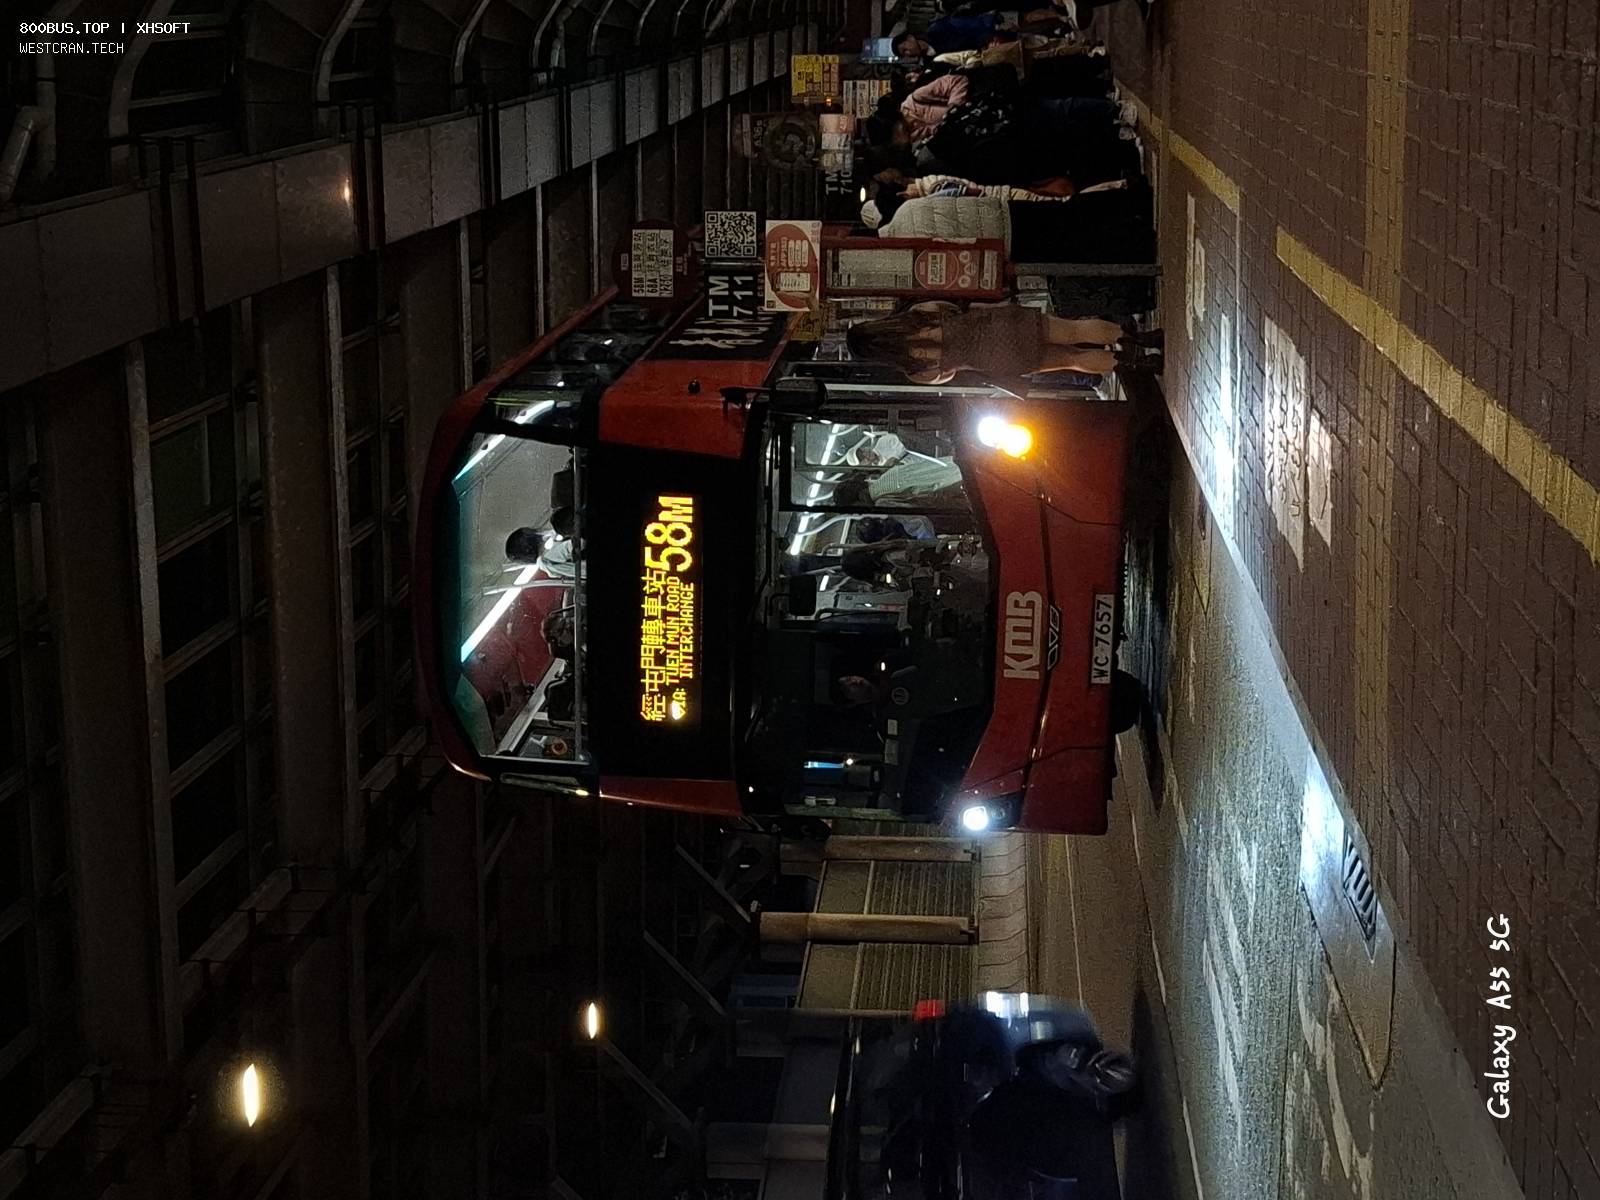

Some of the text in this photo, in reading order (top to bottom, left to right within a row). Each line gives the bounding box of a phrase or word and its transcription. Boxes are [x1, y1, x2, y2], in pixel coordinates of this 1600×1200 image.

[825, 170, 839, 195] TM
[840, 170, 854, 195] 710
[633, 277, 644, 294] 58M
[646, 278, 658, 294] 68A
[708, 275, 730, 317] TM
[733, 275, 754, 318] 711
[644, 495, 694, 572] 58M
[640, 568, 667, 722] 經屯門轉車站
[666, 576, 680, 686] TUEN MUN ROAD
[679, 581, 694, 679] INTERCHANGE
[1003, 590, 1043, 680] KMB
[1093, 599, 1112, 679] WC 7657
